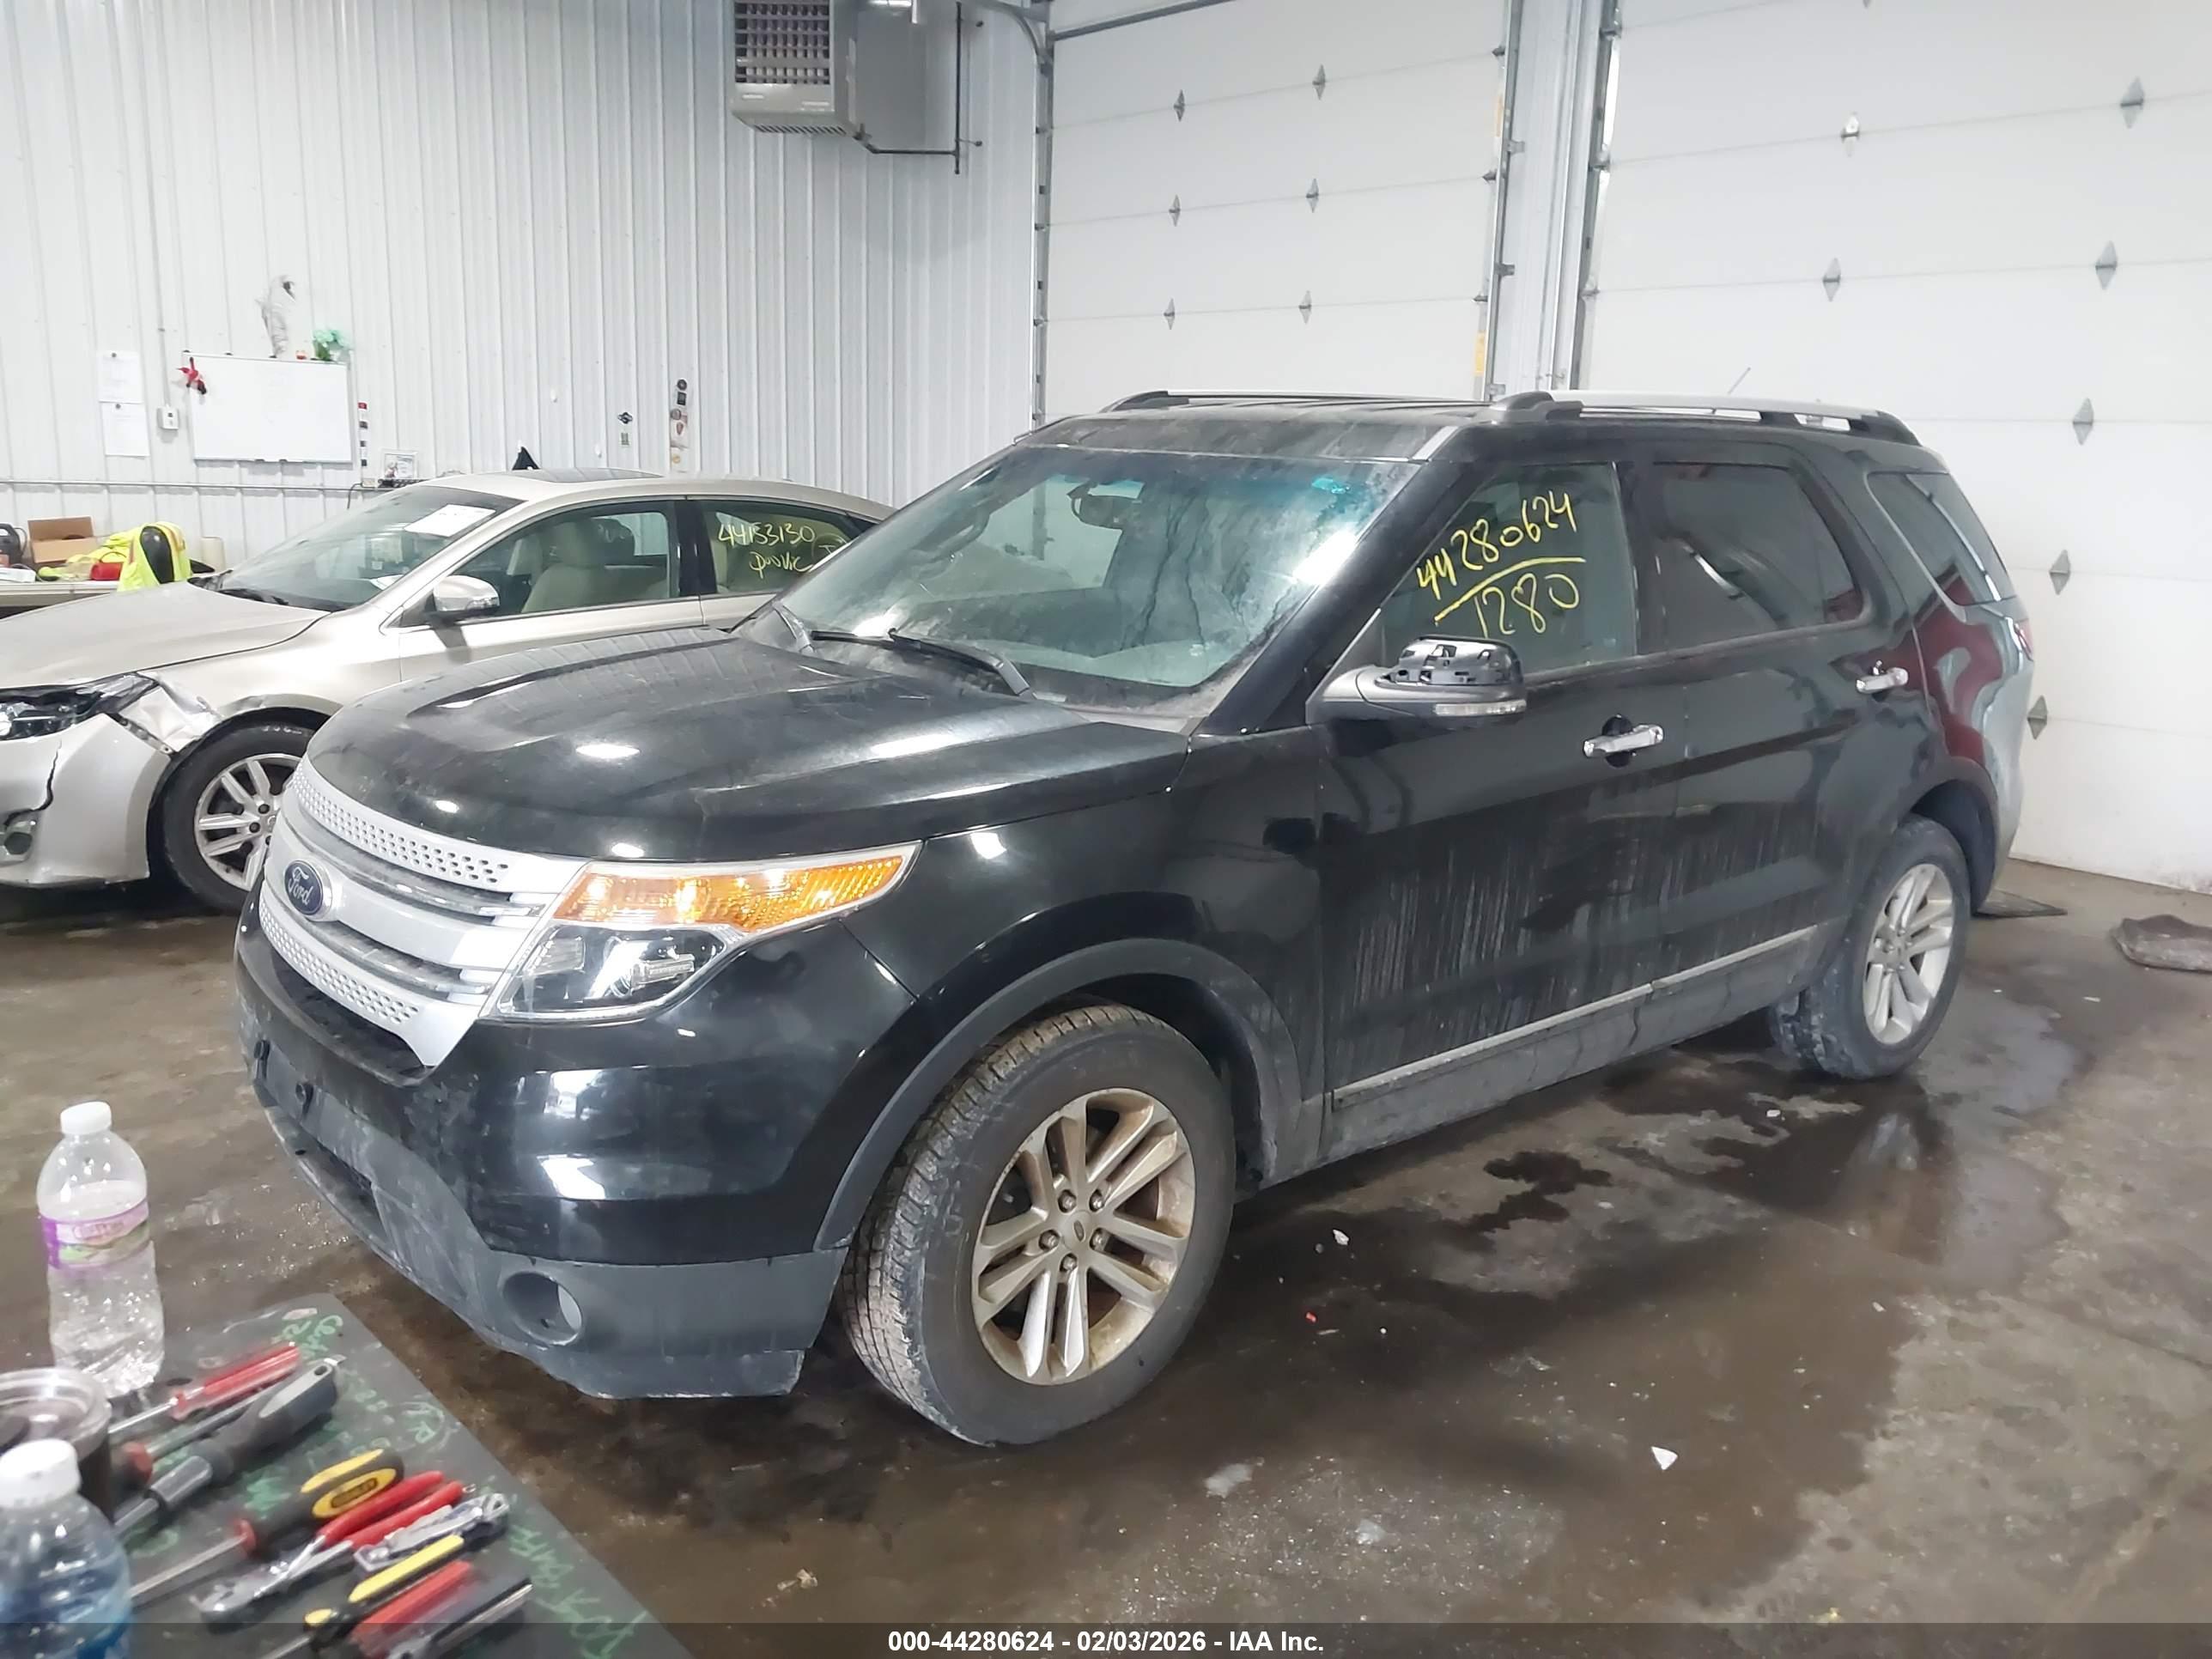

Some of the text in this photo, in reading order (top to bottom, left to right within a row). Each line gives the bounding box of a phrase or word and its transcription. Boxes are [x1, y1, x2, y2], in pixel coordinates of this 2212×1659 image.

[718, 521, 815, 546] 44153130
[1416, 490, 1577, 600] 44280624
[1474, 573, 1580, 638] 1280
[288, 866, 314, 906] Ford
